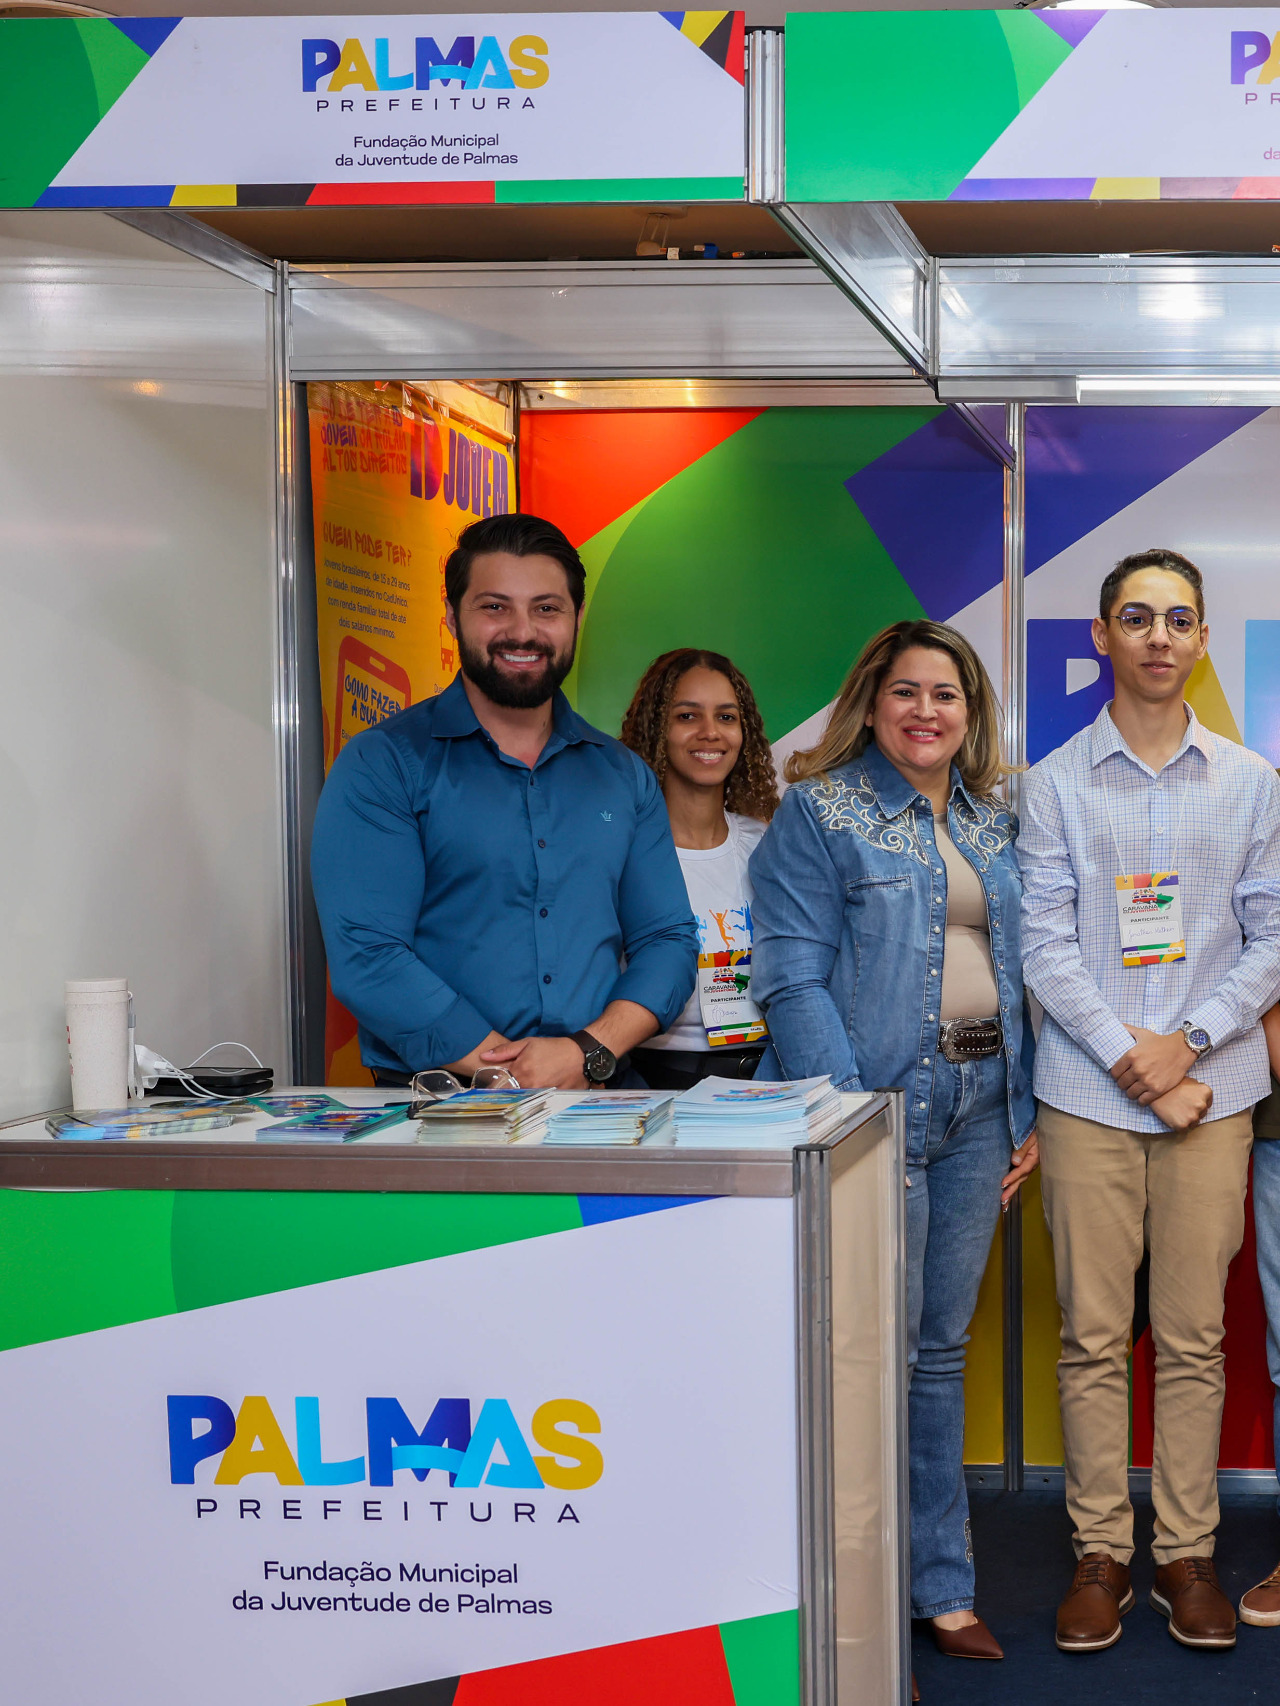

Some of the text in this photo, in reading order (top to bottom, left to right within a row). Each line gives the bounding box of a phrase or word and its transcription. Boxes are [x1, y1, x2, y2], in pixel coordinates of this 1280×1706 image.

[302, 35, 549, 92] PALMAS
[317, 98, 535, 112] PREFEITURA
[354, 134, 499, 151] Fundação Municipal
[335, 152, 518, 166] da Juventude de Palmas
[320, 422, 358, 448] JOVEM
[322, 447, 358, 473] ALTOS
[443, 427, 508, 519] JOVEM
[323, 520, 353, 551] QUEM
[355, 529, 384, 560] PODE
[386, 541, 412, 568] TER?
[351, 698, 358, 719] A
[1122, 904, 1158, 912] CARAVANA
[167, 1395, 604, 1491] PALMAS
[197, 1499, 580, 1523] PREFEITURA
[263, 1560, 518, 1588] Fundação Municipal
[232, 1590, 552, 1615] da Juventude de Palmas
